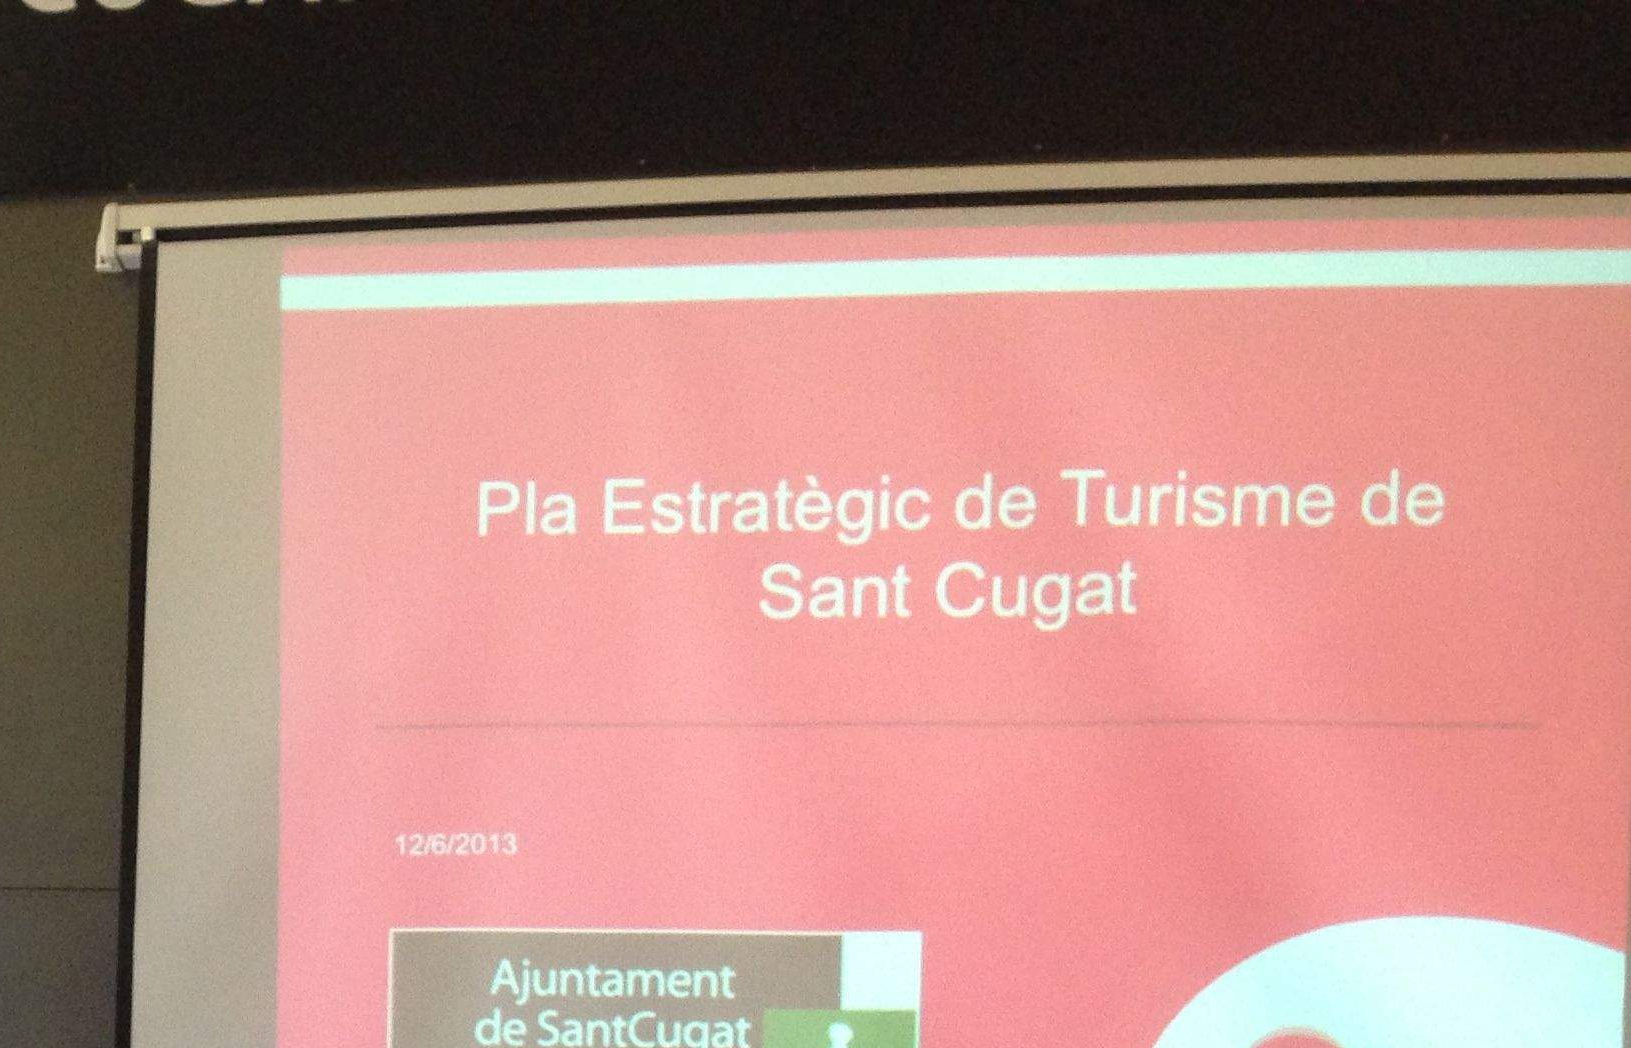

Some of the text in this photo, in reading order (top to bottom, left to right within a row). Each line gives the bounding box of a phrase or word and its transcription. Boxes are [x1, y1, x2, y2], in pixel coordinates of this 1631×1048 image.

[477, 468, 1445, 545] Pla Estratègic de Turisme de
[759, 559, 1137, 631] Sant Cugat
[395, 832, 518, 856] 12/6/2013
[490, 958, 736, 1006] Ajuntament
[474, 1010, 528, 1047] de
